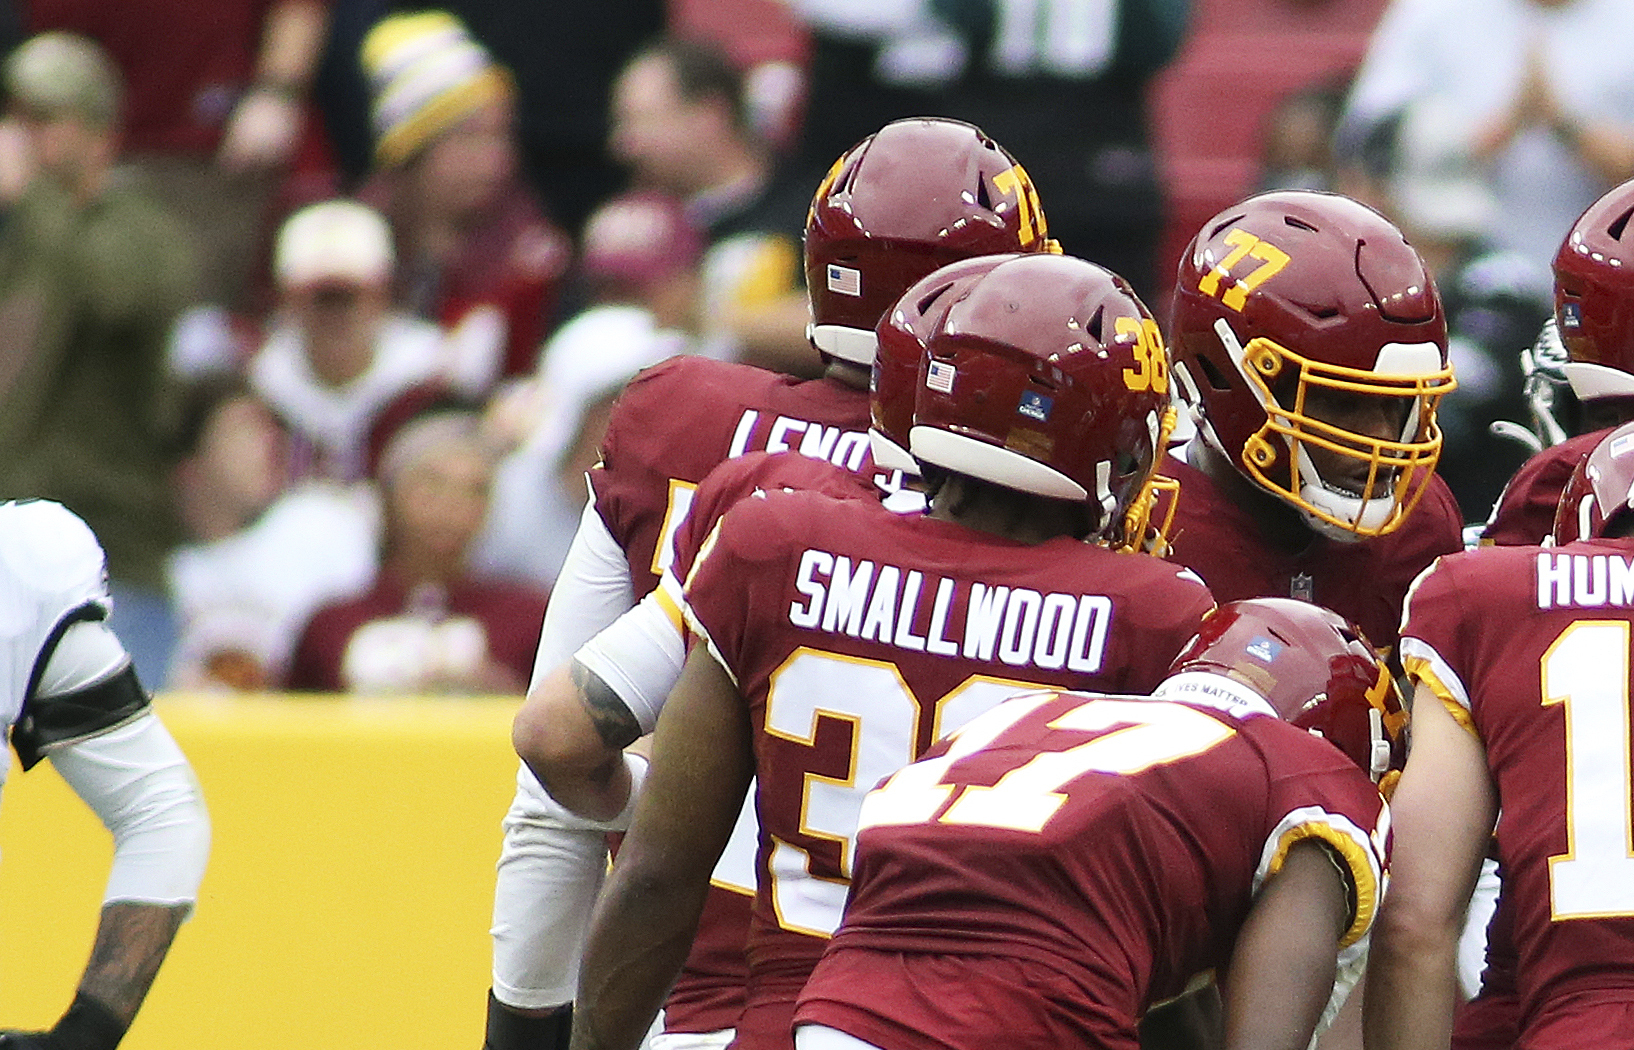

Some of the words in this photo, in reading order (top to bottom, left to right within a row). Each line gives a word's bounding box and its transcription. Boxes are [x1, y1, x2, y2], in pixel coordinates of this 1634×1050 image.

[1198, 227, 1291, 313] 77
[1114, 316, 1170, 394] 38
[789, 549, 1113, 673] SMALLWOOD
[1201, 684, 1248, 707] MATTER
[764, 646, 1069, 938] 3
[857, 689, 1237, 832] 17
